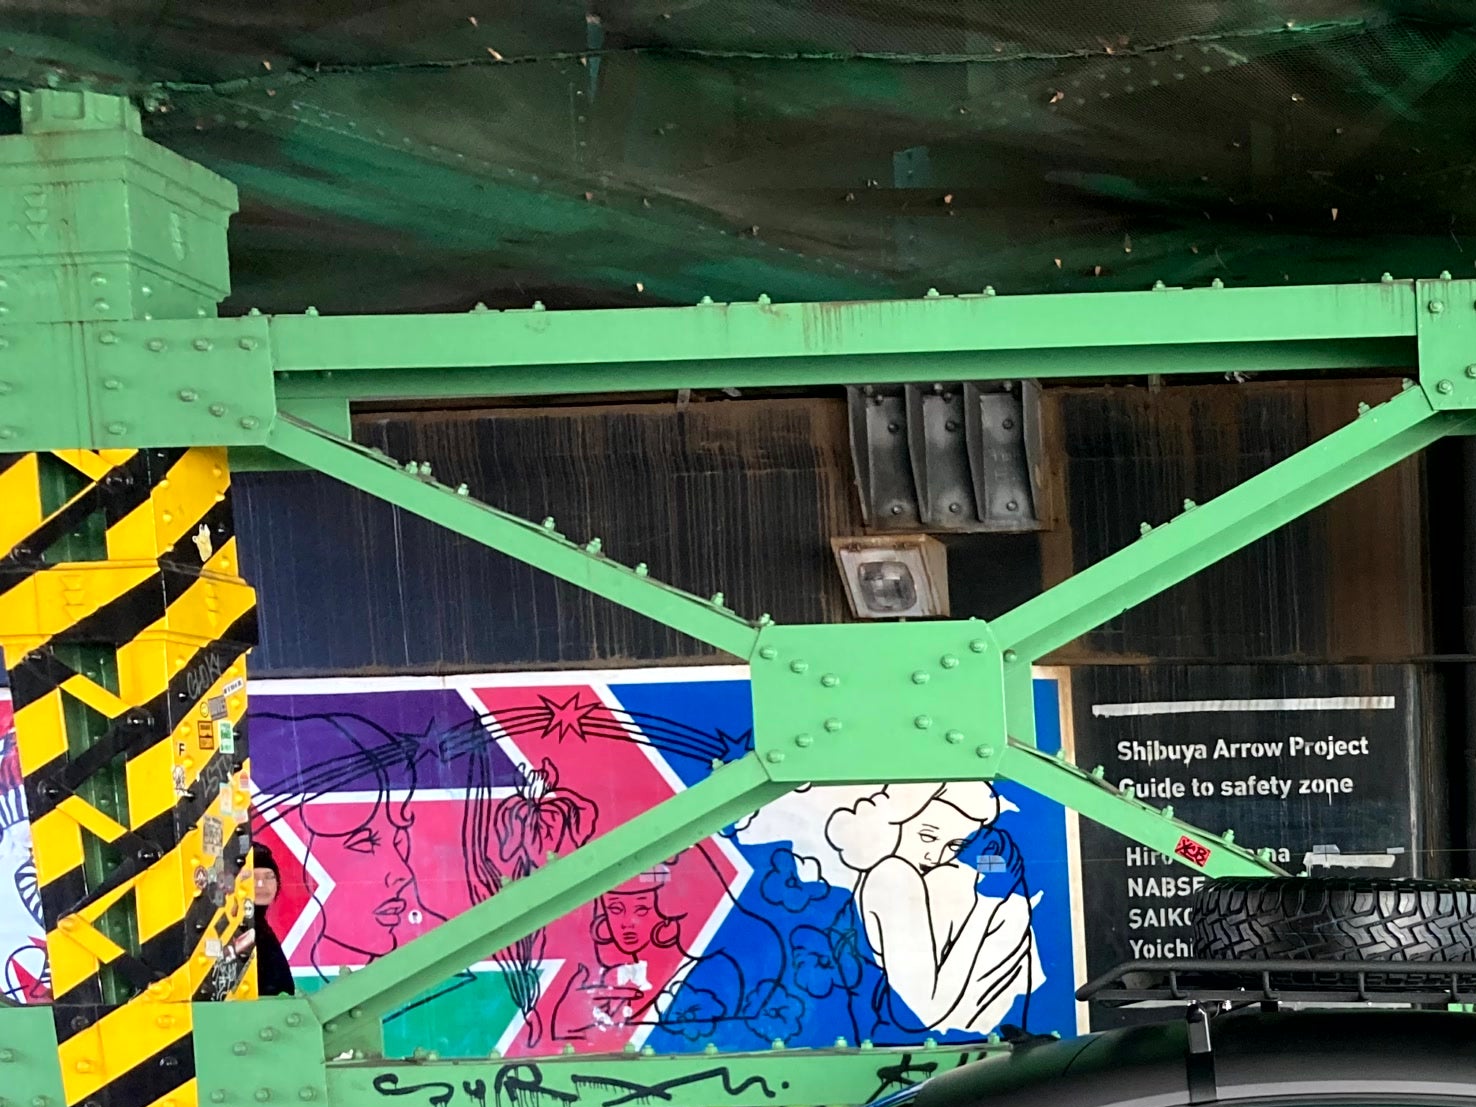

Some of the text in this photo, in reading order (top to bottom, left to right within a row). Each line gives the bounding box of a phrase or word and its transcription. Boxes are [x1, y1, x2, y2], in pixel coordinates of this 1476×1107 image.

[1117, 735, 1369, 765] Shibuya Arrow Project
[1191, 778, 1215, 797] to
[1220, 775, 1292, 799] safety
[1299, 777, 1354, 795] zone
